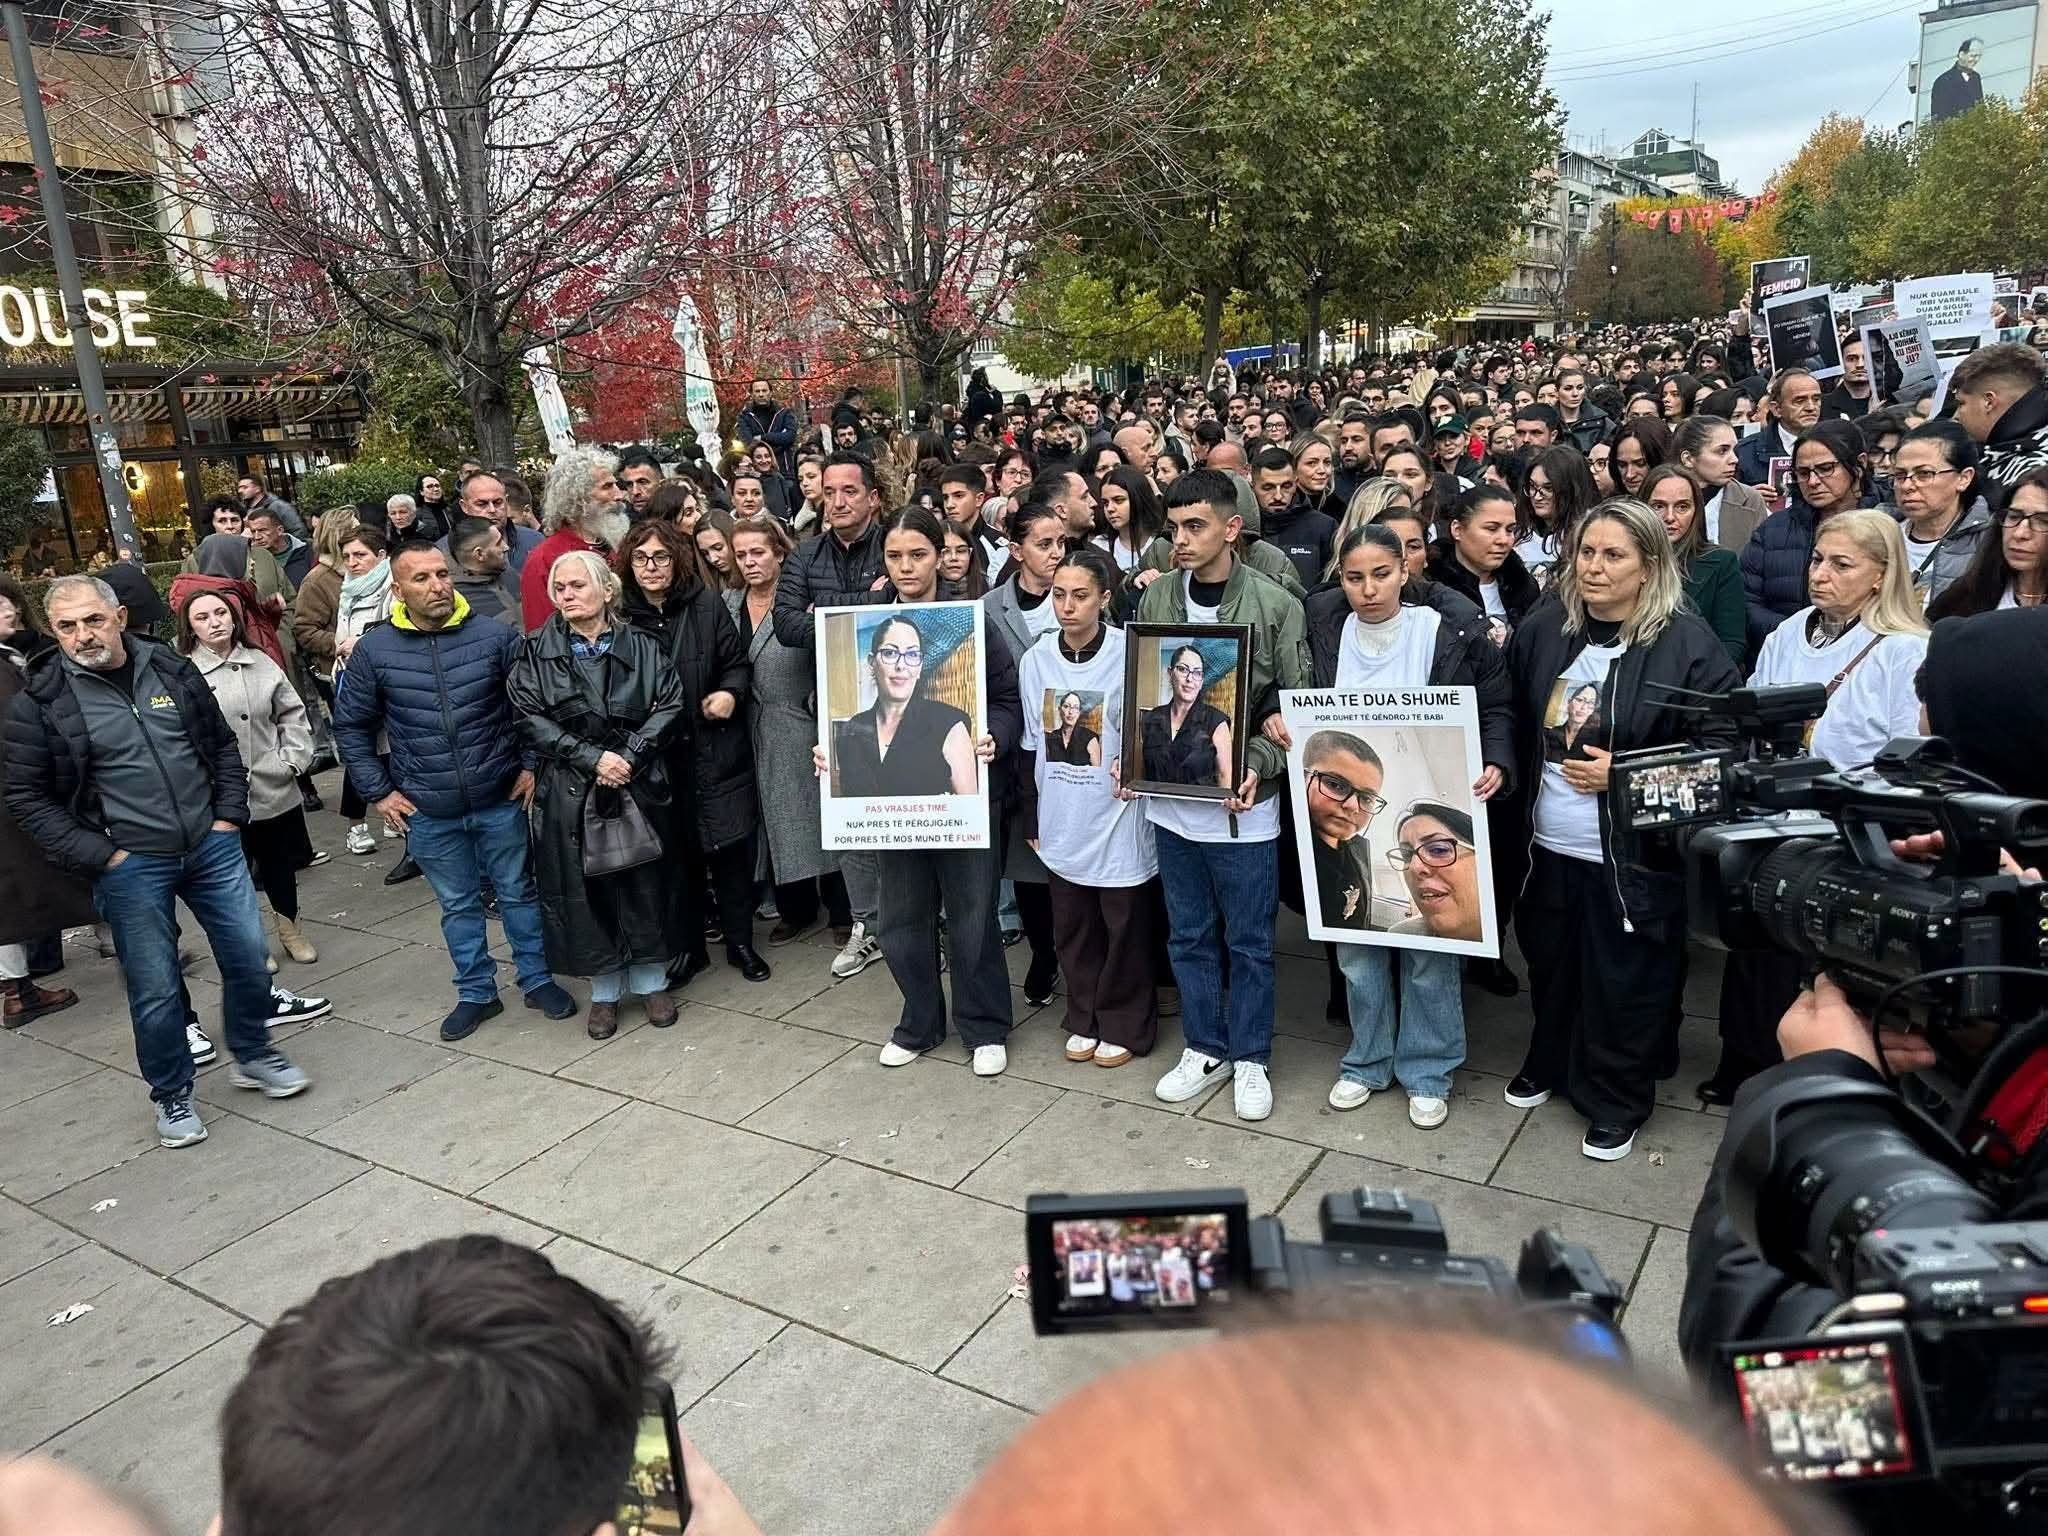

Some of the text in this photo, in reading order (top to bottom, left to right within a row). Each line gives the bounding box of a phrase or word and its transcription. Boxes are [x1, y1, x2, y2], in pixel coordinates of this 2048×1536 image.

[1760, 278, 1801, 297] FEMICID
[1909, 287, 1980, 300] NUK DUAM LULE
[1915, 302, 1973, 313] DUAM SIGURI
[1904, 352, 1920, 364] JU?
[1291, 689, 1461, 708] NANA TE DUA SHUMË
[865, 804, 948, 814] PAS VRASJES TIME
[846, 821, 865, 829] NUK
[867, 820, 890, 828] PRES
[834, 836, 853, 844] POR
[855, 835, 878, 843] PRES
[894, 835, 913, 843] MOS
[915, 834, 941, 843] MUND
[1889, 906, 1918, 920] SONY
